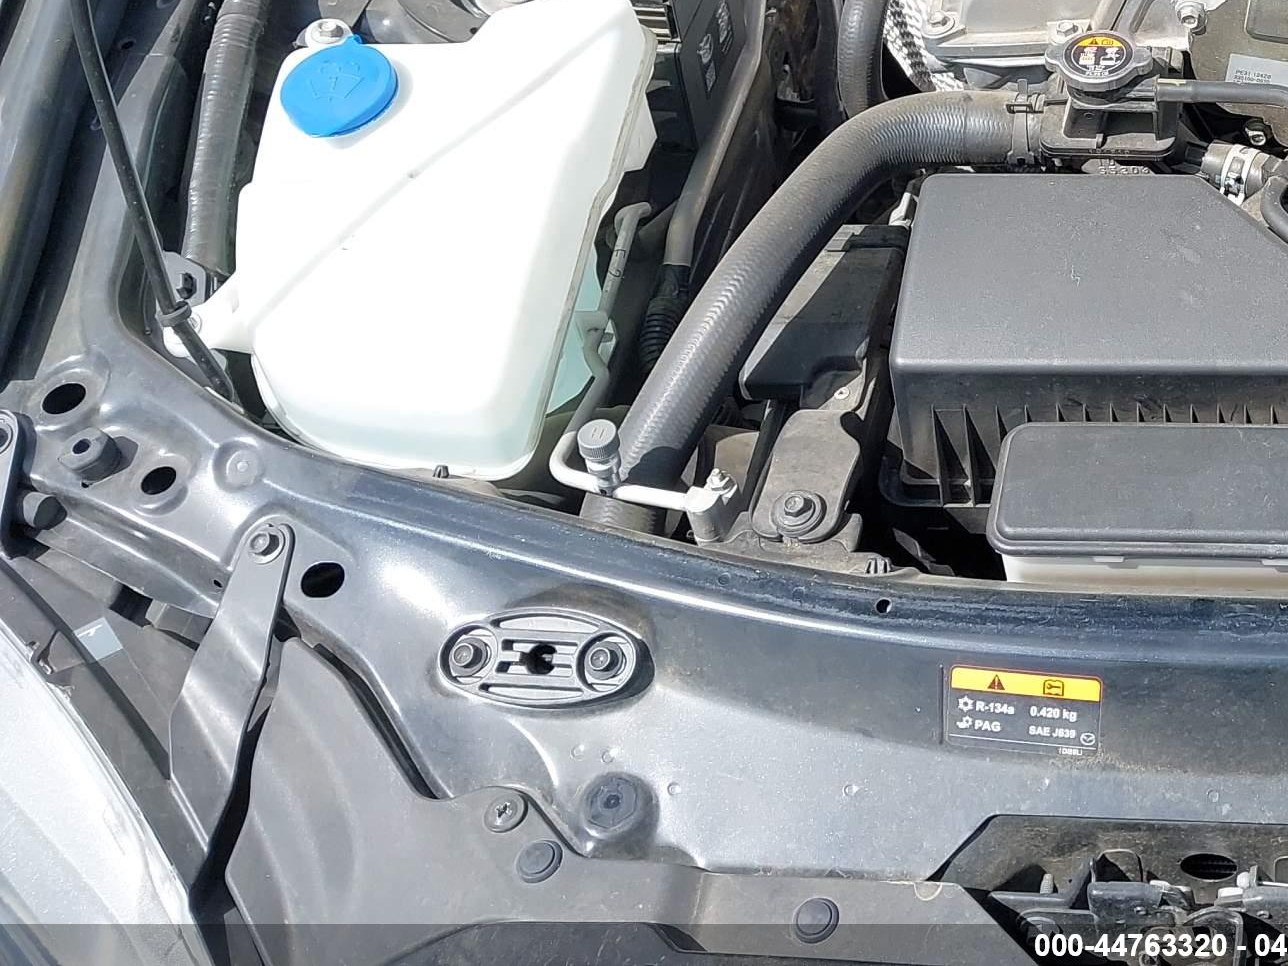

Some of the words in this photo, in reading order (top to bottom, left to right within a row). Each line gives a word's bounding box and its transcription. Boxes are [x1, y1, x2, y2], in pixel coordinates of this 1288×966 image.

[975, 700, 1015, 715] R-134a
[1030, 705, 1060, 719] 0.420
[1062, 708, 1078, 722] kg
[974, 719, 1001, 732] PAG
[1029, 725, 1049, 737] SAE
[1052, 726, 1076, 739] J639
